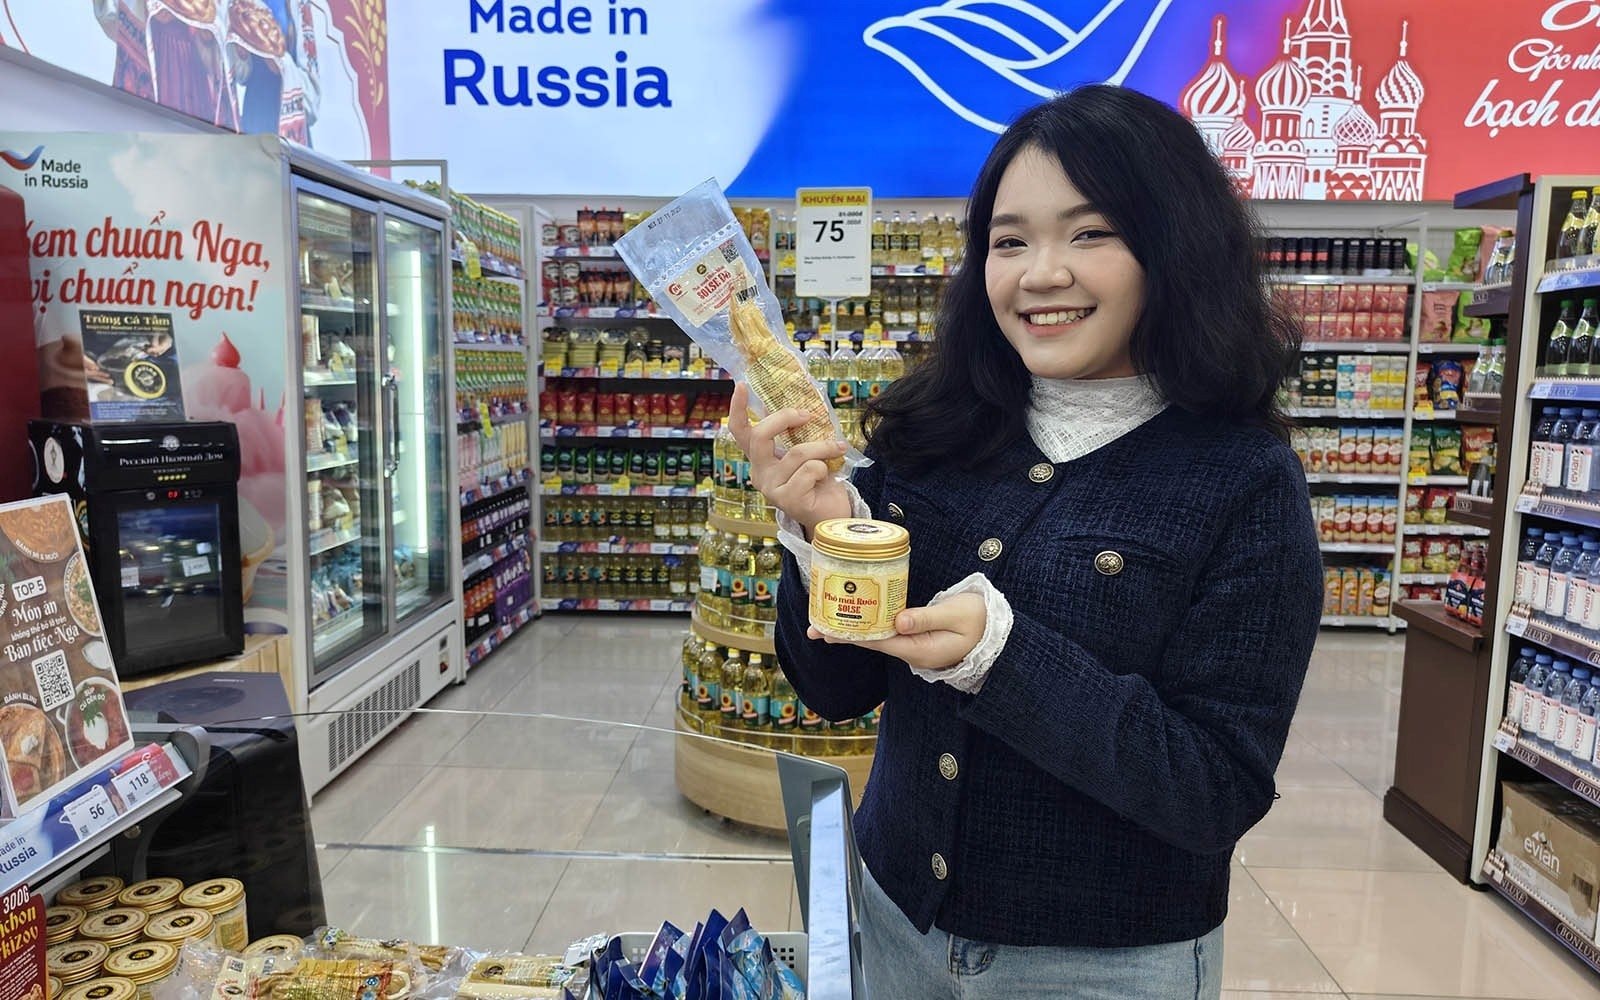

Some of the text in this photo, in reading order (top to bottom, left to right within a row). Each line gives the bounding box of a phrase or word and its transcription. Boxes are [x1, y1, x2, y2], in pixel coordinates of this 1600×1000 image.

[469, 0, 648, 35] Made in
[443, 48, 673, 108] Russia
[1464, 79, 1564, 138] bạch
[41, 159, 82, 173] Made
[24, 173, 89, 189] in Russia
[813, 221, 844, 242] 75
[86, 211, 183, 260] chuẩn
[192, 219, 270, 278] Nga,
[59, 262, 156, 306] chuẩn
[164, 280, 259, 321] ngon!
[83, 314, 121, 326] Trứng
[124, 315, 140, 326] Cá
[14, 579, 44, 598] TOP 5
[11, 601, 42, 627] Món
[4, 623, 80, 662] Bàn tiệc Nga
[1525, 626, 1550, 642] LUXE
[1514, 744, 1537, 763] LUXE
[129, 773, 149, 791] 118
[89, 803, 105, 820] 56
[0, 836, 26, 857] ade in
[1524, 837, 1560, 873] evian
[3, 885, 30, 914] 300G
[0, 926, 39, 959] kizov
